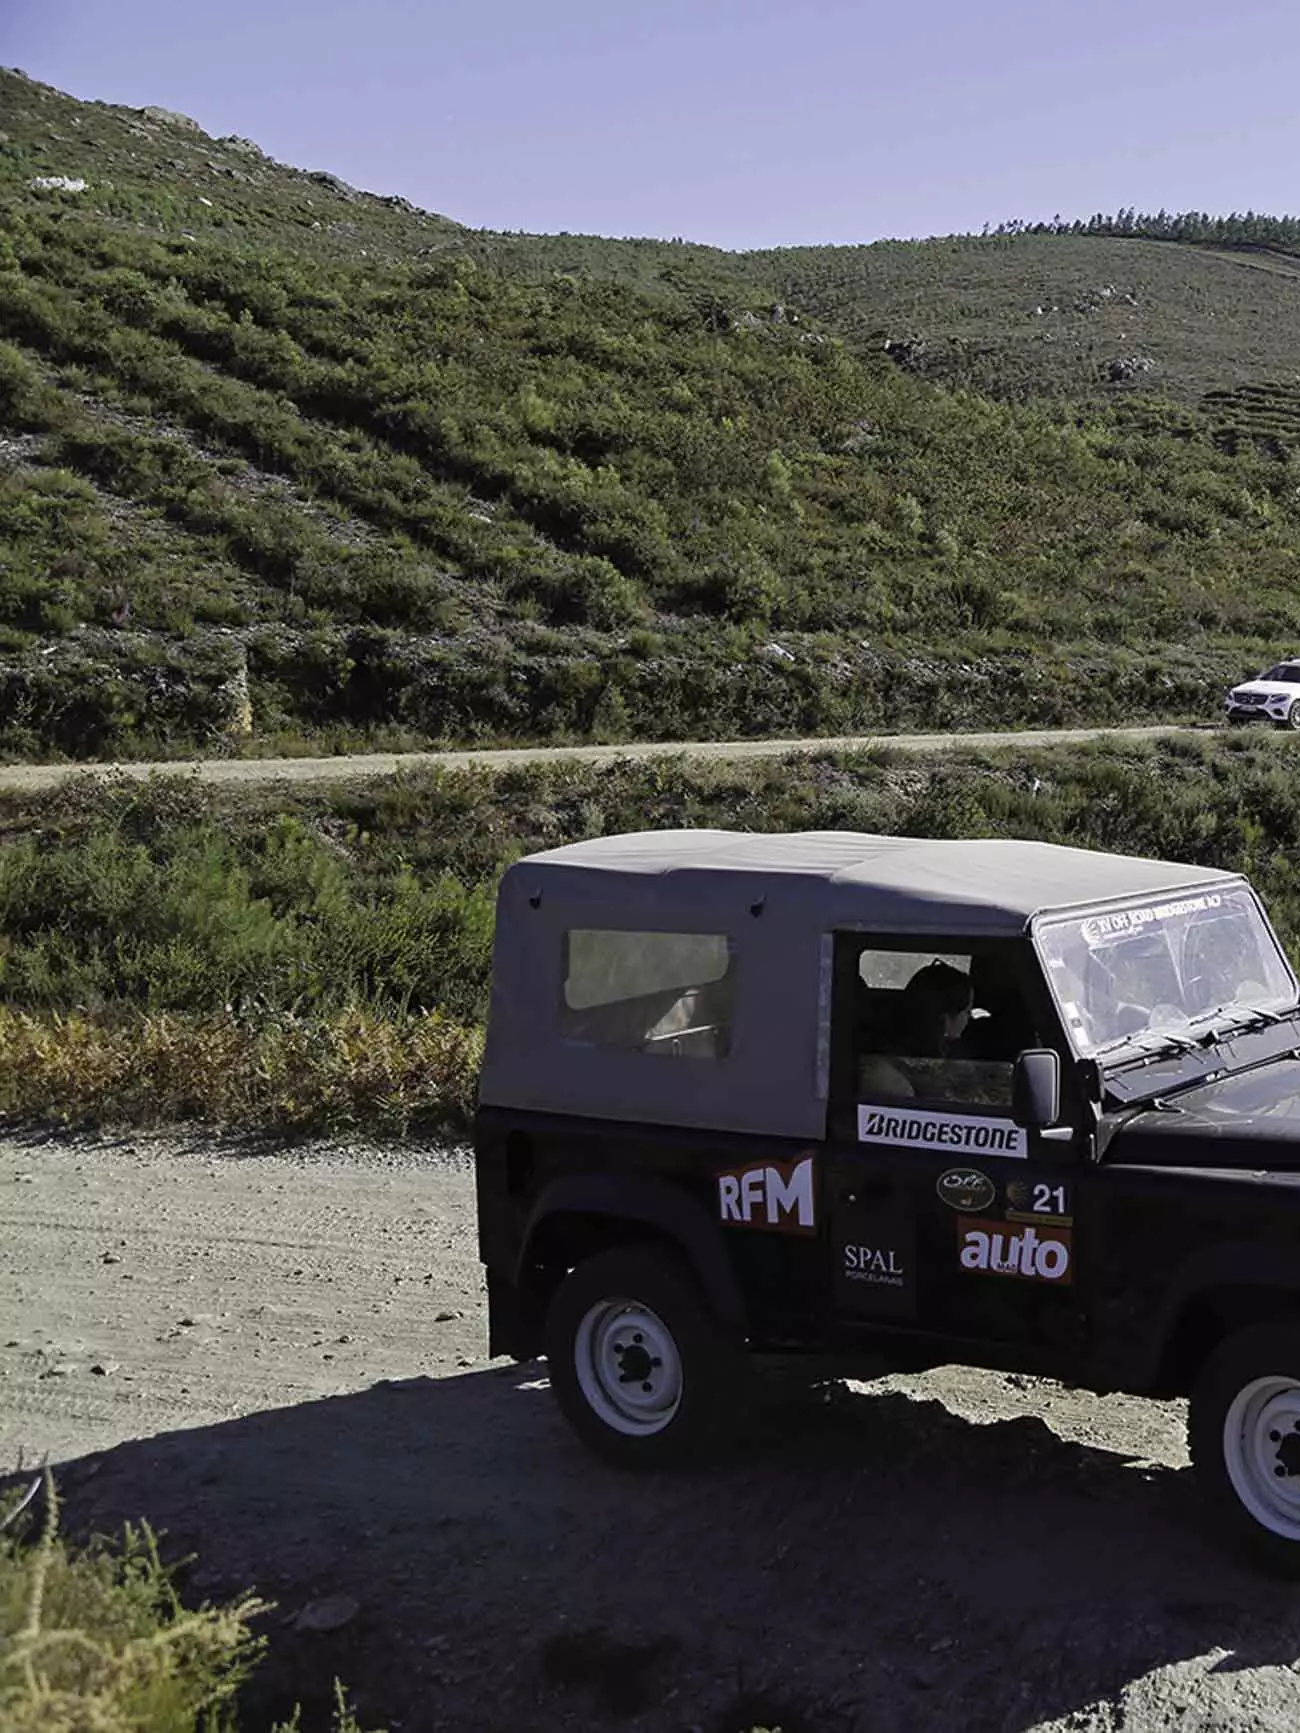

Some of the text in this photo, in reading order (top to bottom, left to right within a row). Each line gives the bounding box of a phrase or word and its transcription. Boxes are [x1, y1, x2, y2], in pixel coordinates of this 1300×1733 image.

[866, 1112, 1019, 1150] BRIDGESTONE
[719, 1158, 814, 1226] RFM
[1033, 1183, 1065, 1213] 21
[845, 1244, 903, 1274] SPAL
[960, 1227, 1068, 1278] auto
